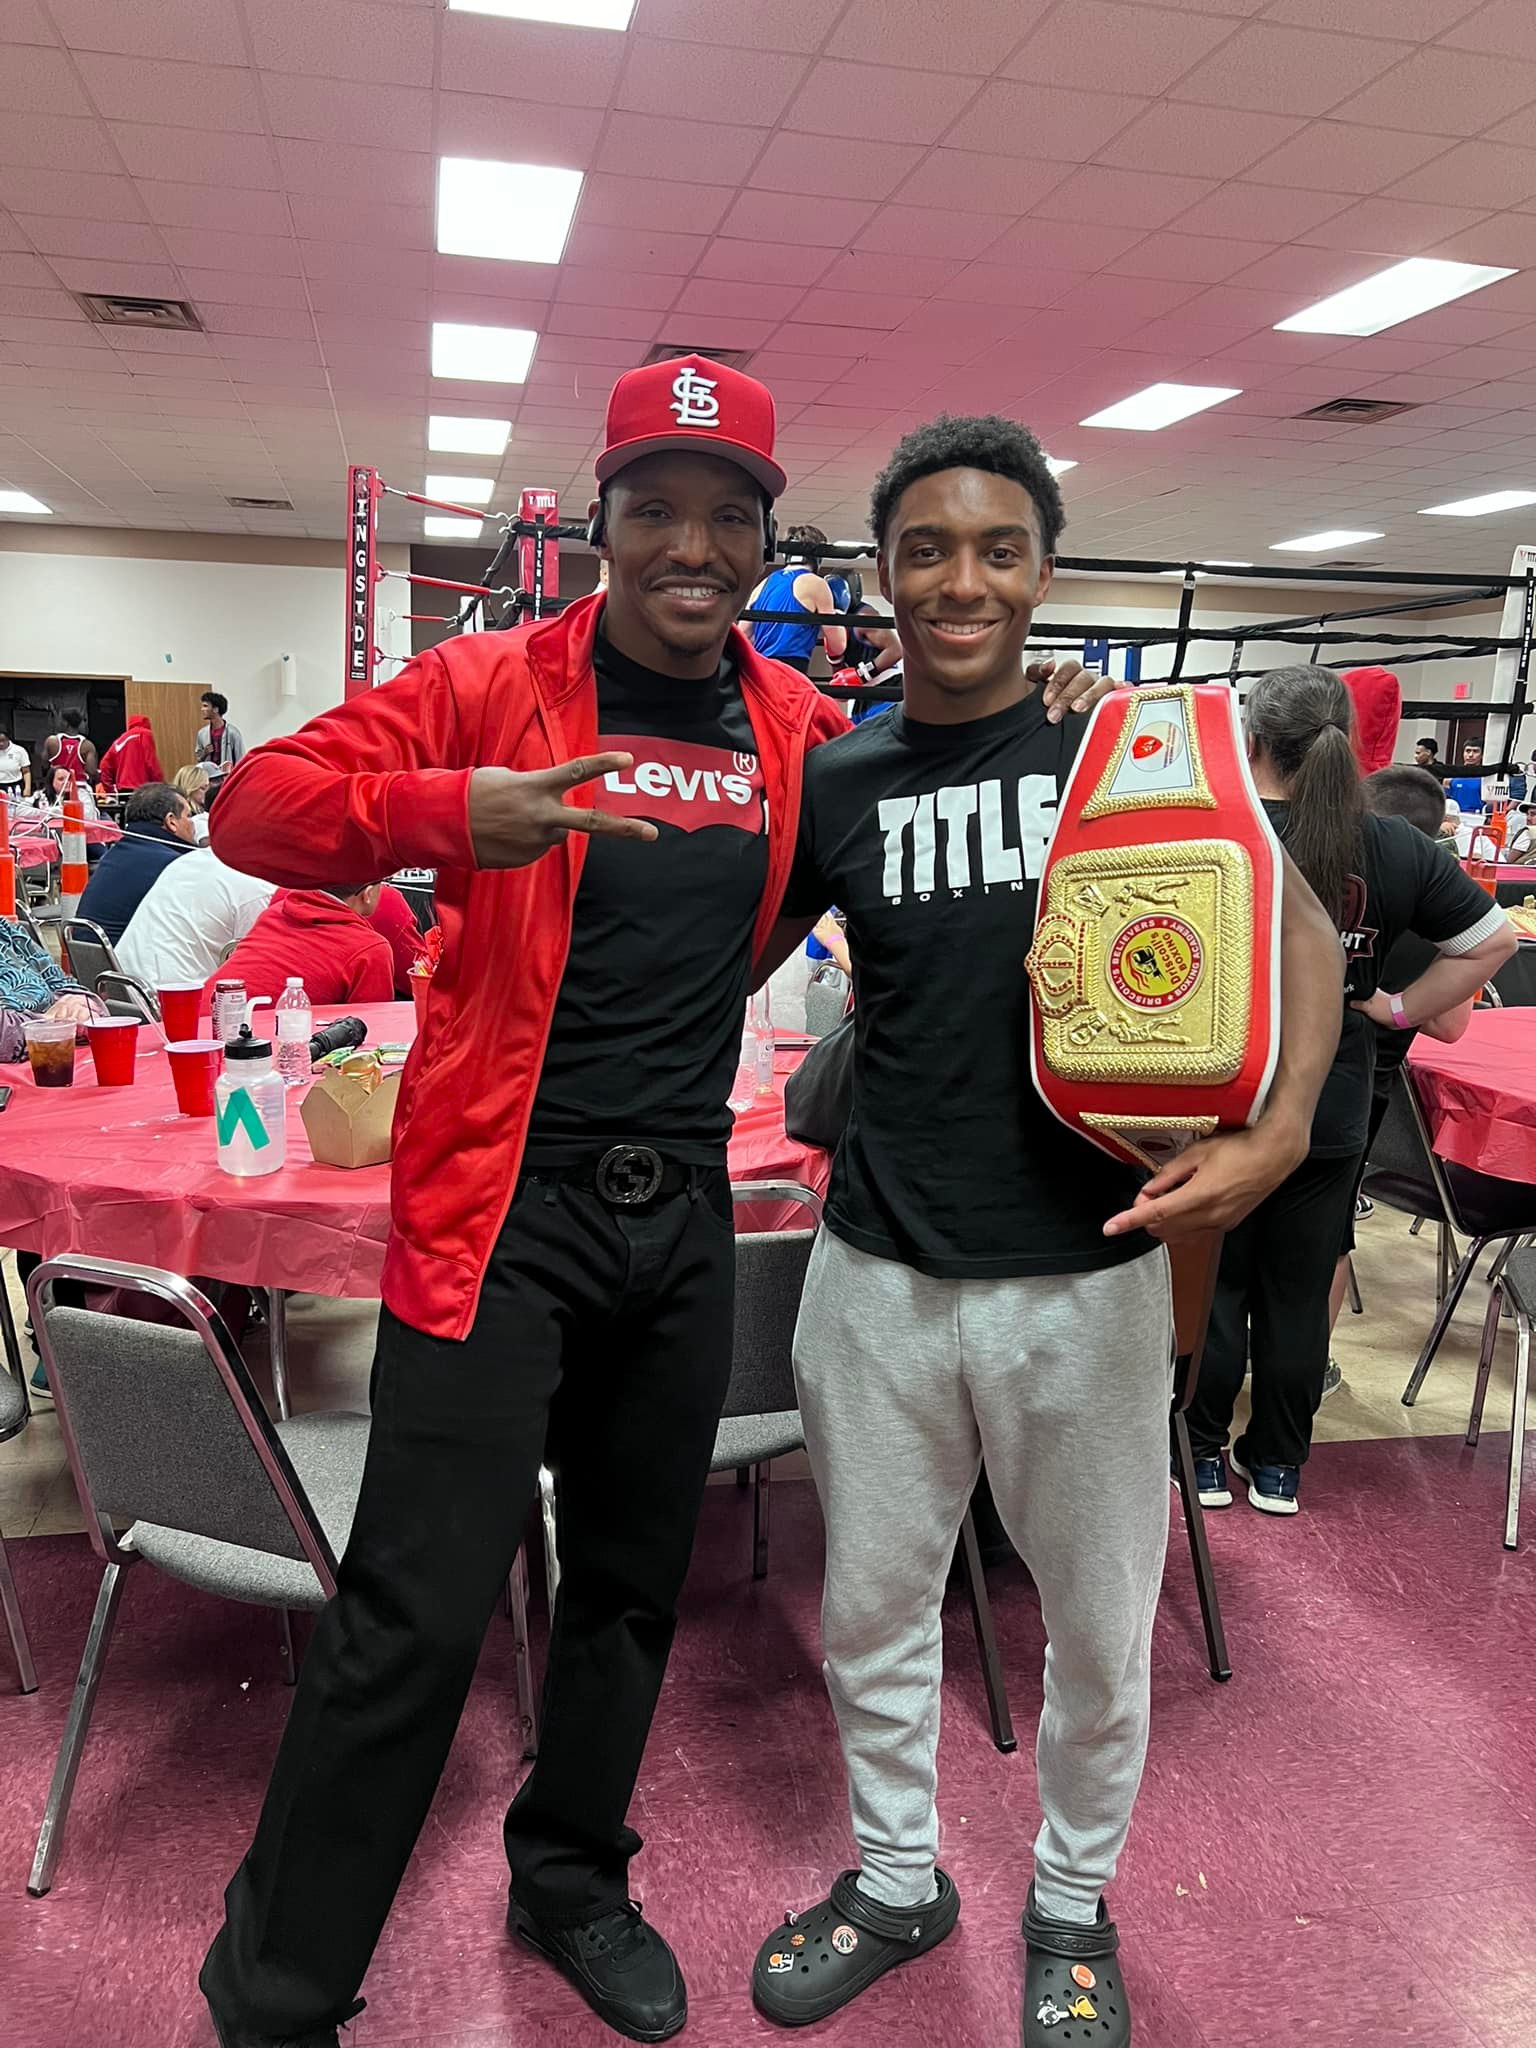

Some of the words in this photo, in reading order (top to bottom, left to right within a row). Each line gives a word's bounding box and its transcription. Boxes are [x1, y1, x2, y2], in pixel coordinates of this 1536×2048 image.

[536, 495, 556, 508] TITLE
[353, 471, 368, 667] INGSIDE
[878, 774, 1058, 897] TITLE
[892, 881, 1024, 906] BOXIN
[1111, 919, 1156, 965] BELIEVERS
[1150, 931, 1182, 985] Driscoll's
[1162, 932, 1187, 971] BOXING
[1169, 921, 1201, 959] ACADEMY
[1112, 968, 1162, 1005] DRISCOLL'S
[1174, 962, 1200, 997] BOXING
